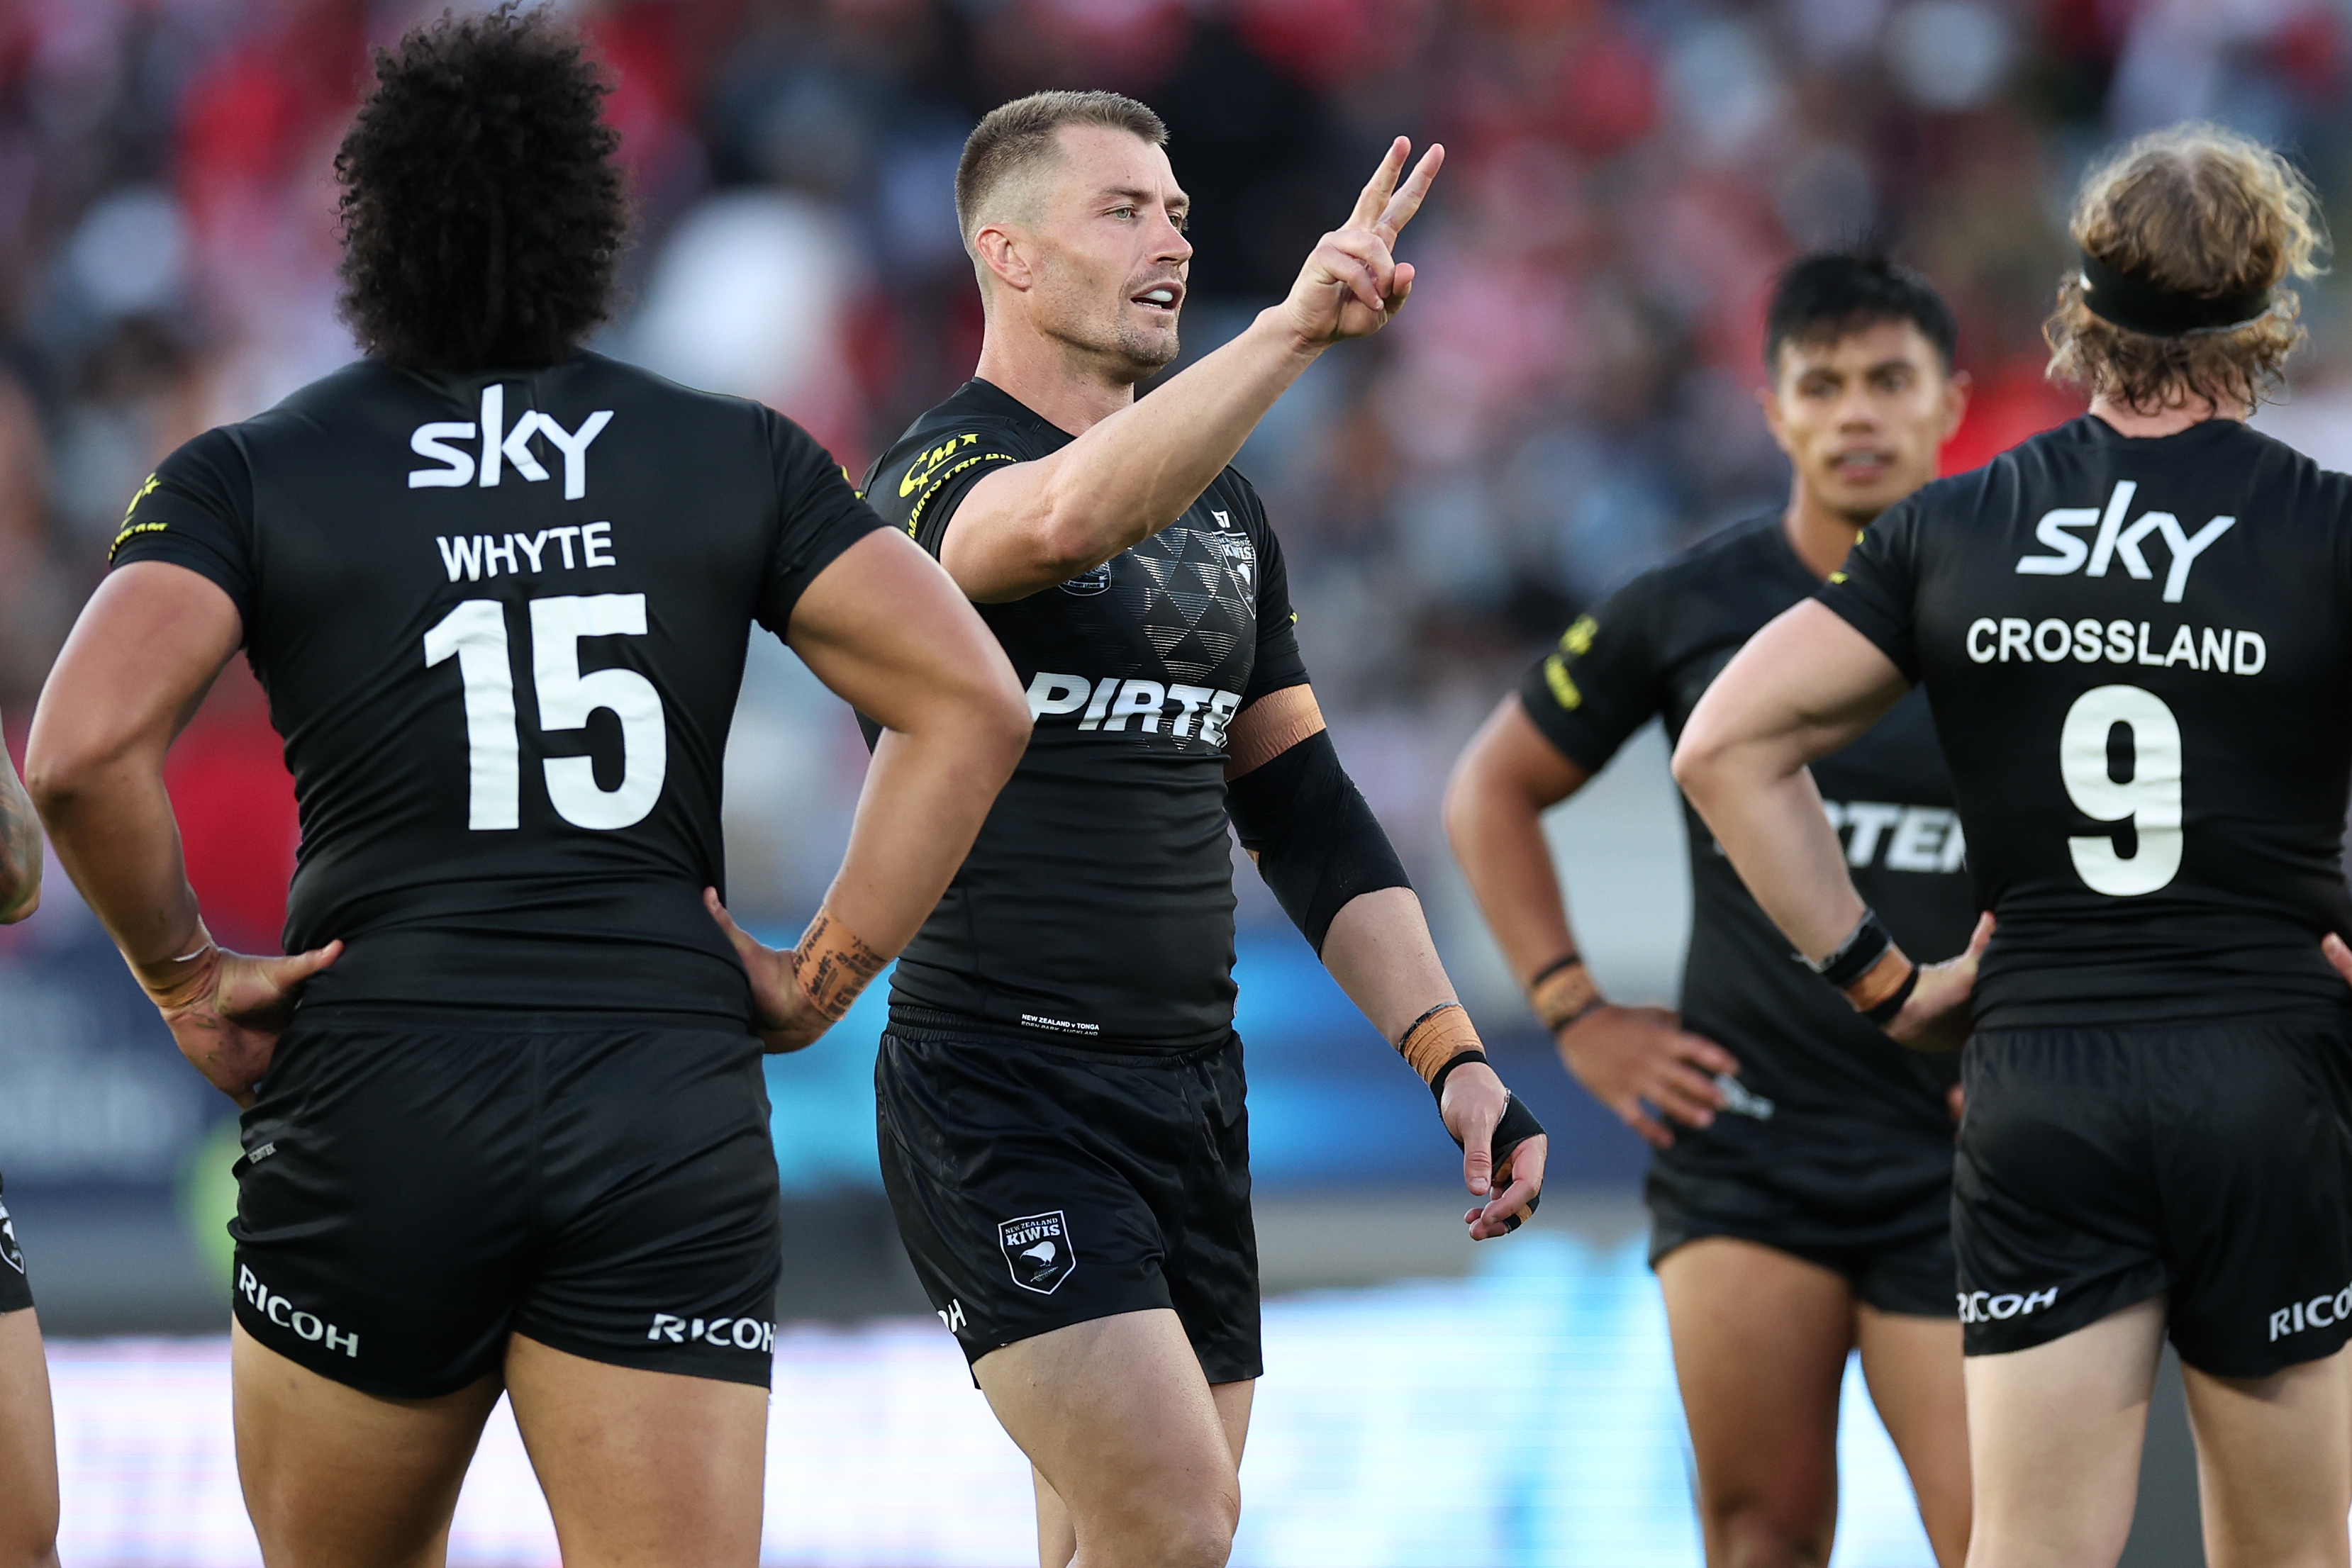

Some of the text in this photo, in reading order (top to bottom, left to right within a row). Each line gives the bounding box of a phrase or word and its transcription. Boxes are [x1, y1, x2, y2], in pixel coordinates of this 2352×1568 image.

[436, 522, 616, 583] WHYTE
[1966, 617, 2267, 676] CROSSLAND
[423, 593, 667, 831] 15
[1026, 672, 1242, 749] PIRTE
[2060, 683, 2183, 896] 9
[1022, 1014, 1038, 1022] NEW
[1039, 1017, 1070, 1027] ZEALAND
[1005, 1218, 1058, 1234] NEW ZEALAND
[1006, 1224, 1061, 1245] KIWIS
[239, 1262, 359, 1358] RICOH
[647, 1313, 777, 1354] RICOH
[2268, 1280, 2352, 1343] RICO
